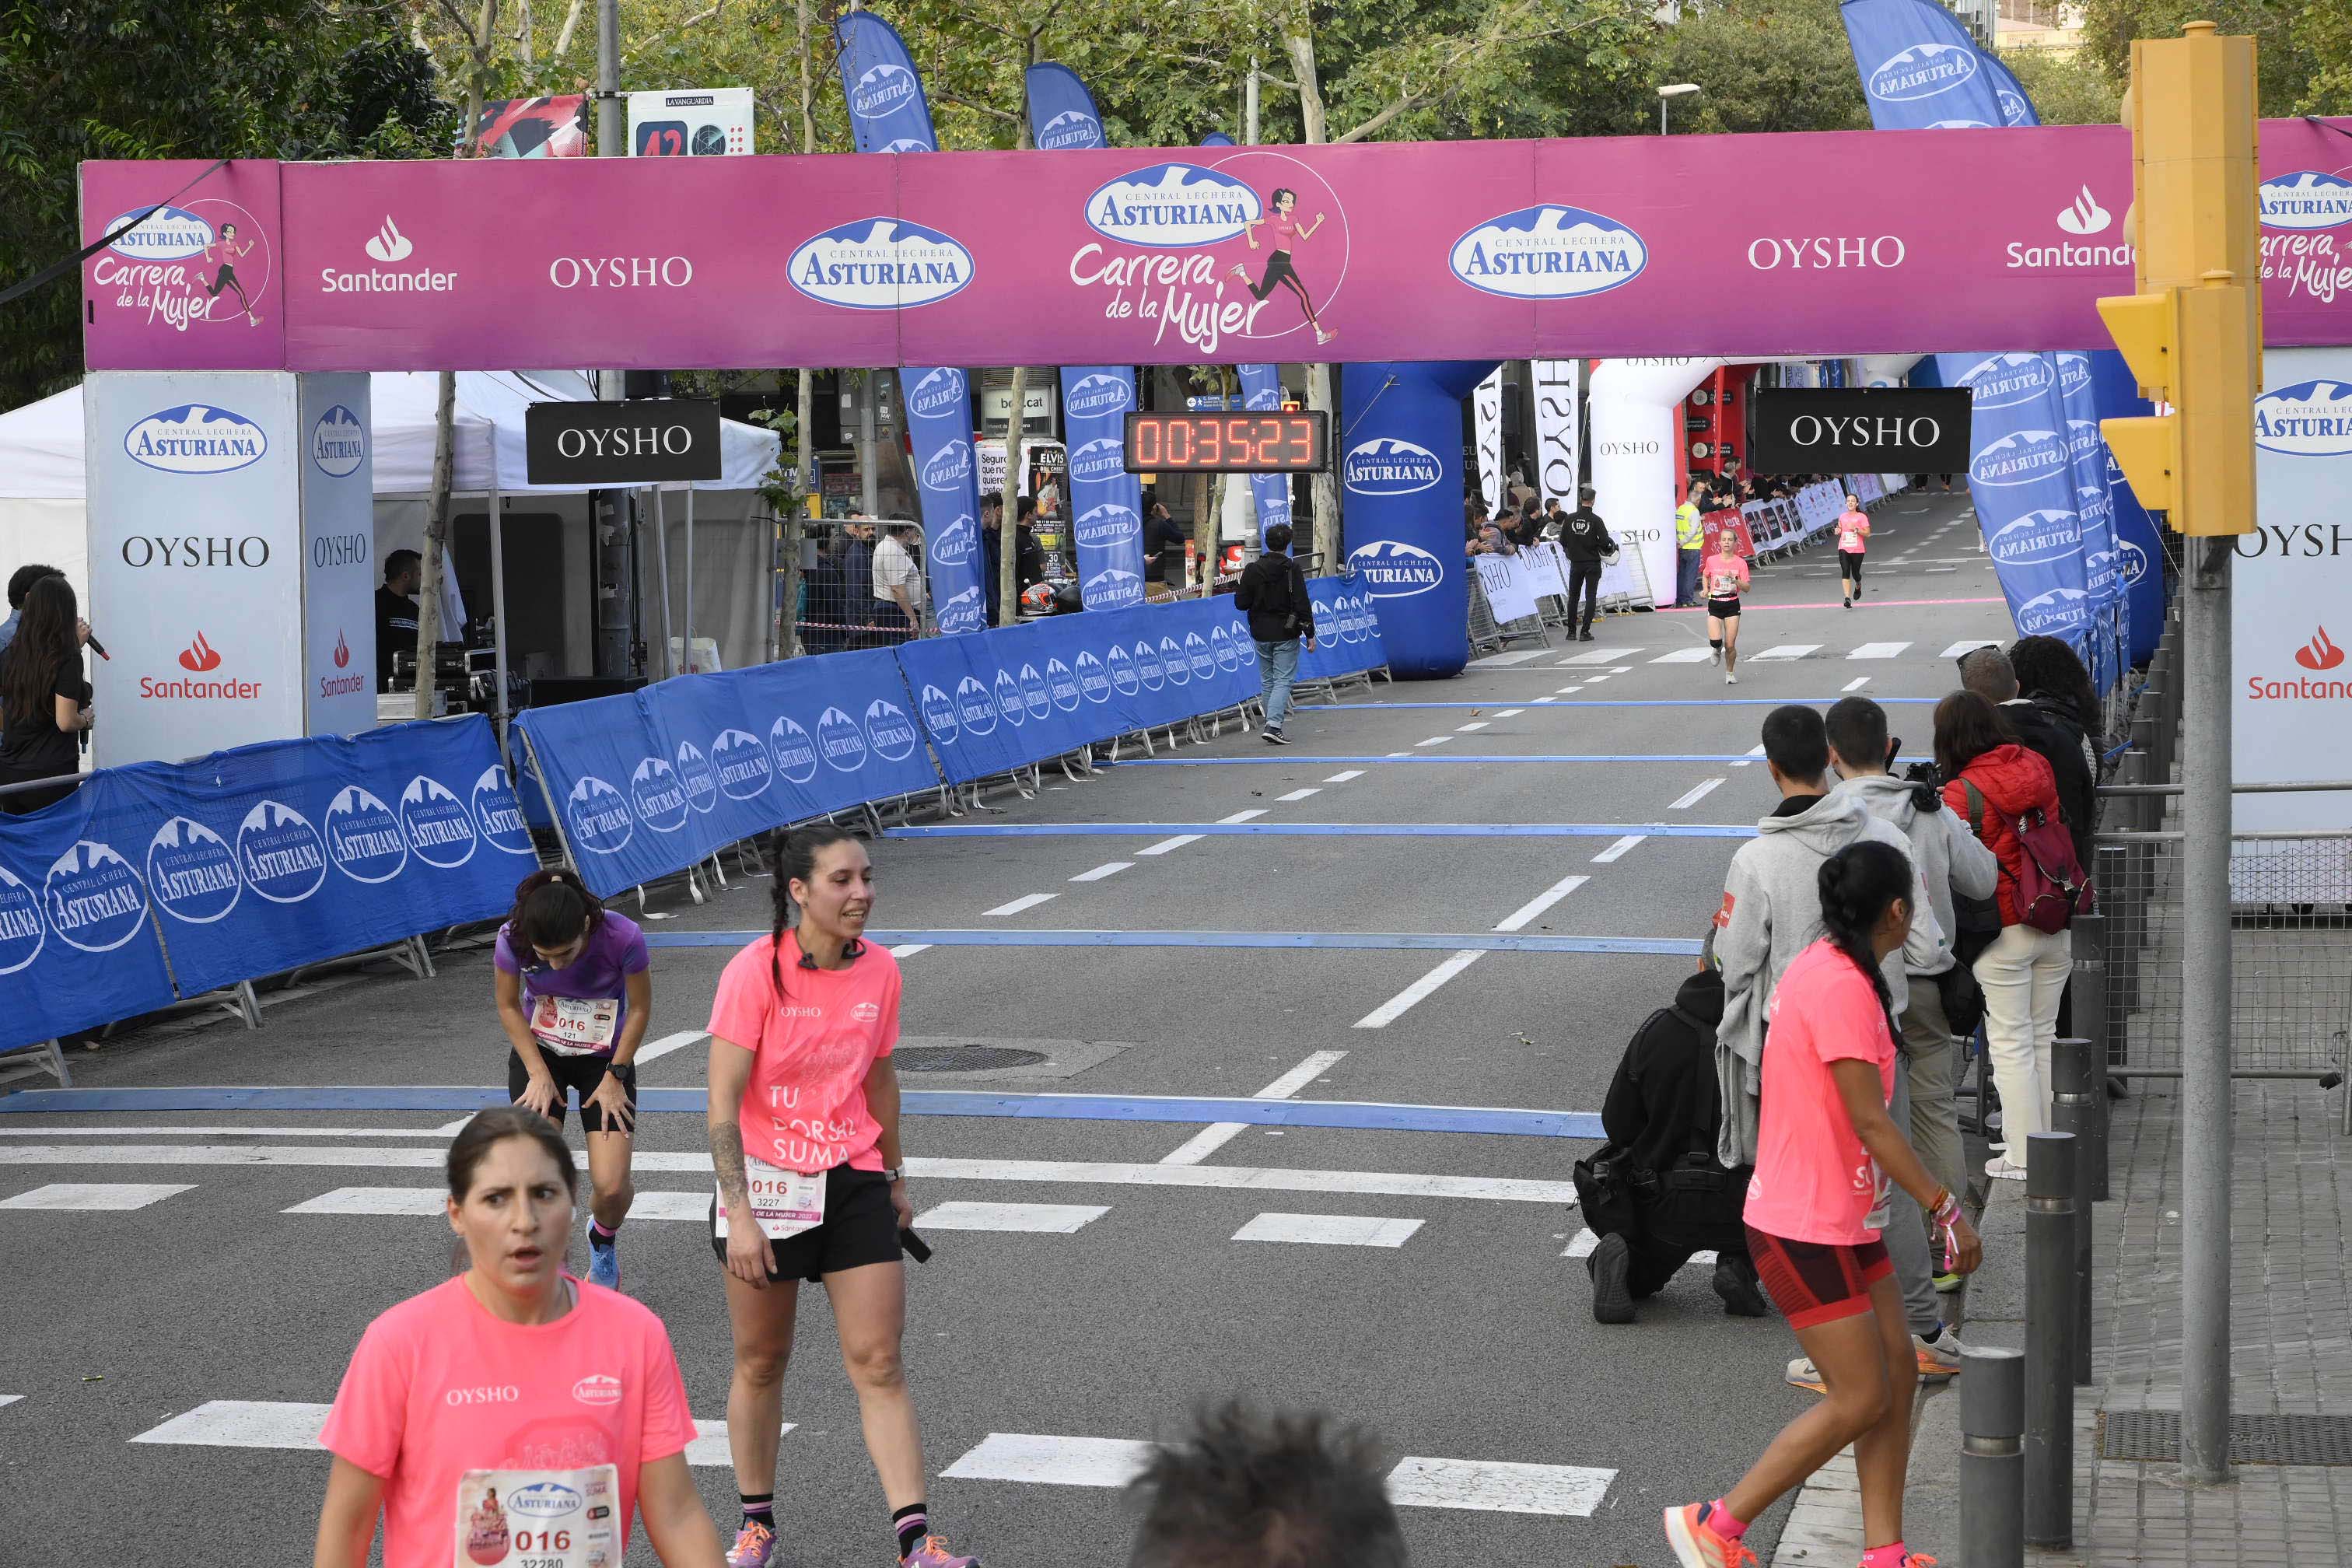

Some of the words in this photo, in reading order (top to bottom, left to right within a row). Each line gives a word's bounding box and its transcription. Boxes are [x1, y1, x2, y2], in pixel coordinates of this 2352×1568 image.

[1125, 191, 1181, 201] CENTRAL
[1187, 191, 1243, 200] LECHERA
[1098, 194, 1248, 226] ASTURIANA
[112, 224, 205, 247] ASTURIANA
[1496, 237, 1556, 247] CENTRAL
[1563, 236, 1626, 246] LECHERA
[2259, 234, 2334, 256] arrera
[830, 249, 889, 259] CENTRAL
[894, 248, 954, 258] LECHERA
[1069, 243, 1217, 286] Carrera
[1465, 240, 1632, 275] ASTURIANA
[1748, 236, 1906, 270] OYSHO
[93, 257, 186, 287] Carrera
[549, 256, 693, 289] OYSHO
[801, 252, 960, 285] ASTURIANA
[2278, 257, 2292, 278] la
[321, 268, 457, 292] Santander
[117, 287, 133, 308] de
[137, 286, 149, 308] la
[148, 284, 220, 331] Mujer
[1105, 289, 1132, 318] de
[1139, 285, 1157, 318] la
[1153, 279, 1269, 354] Mujer
[558, 425, 692, 458] OYSHO
[1138, 420, 1311, 464] 00:35:23
[1790, 415, 1940, 447] OYSHO
[136, 430, 257, 457] ASTURIANA
[316, 432, 362, 460] ASTURIANA
[1600, 441, 1659, 456] OYSHO
[1040, 453, 1064, 464] ELVIS
[982, 467, 995, 475] que
[1347, 461, 1435, 483] ASTURIANA
[122, 536, 269, 568] OYSHO
[314, 533, 366, 568] OYSHO
[1048, 554, 1058, 562] 30
[140, 677, 262, 699] Santander
[321, 672, 364, 698] Santander
[774, 744, 814, 768] ASTURIANA
[822, 733, 864, 758] ASTURIANA
[715, 757, 770, 786] ASTURIANA
[340, 819, 366, 831] CENTRAL
[367, 815, 392, 827] LECHERA
[413, 807, 436, 818] CENTRAL
[436, 804, 460, 815] LECHERA
[253, 835, 281, 849] CENTRAL
[282, 830, 311, 844] LECHERA
[406, 813, 473, 849] ASTURIANA
[333, 824, 404, 863] ASTURIANA
[165, 853, 195, 866] CENTRAL
[196, 848, 225, 862] LECHERA
[245, 843, 323, 883] ASTURIANA
[156, 861, 237, 902] ASTURIANA
[54, 884, 142, 930] ASTURIANA
[558, 1017, 586, 1031] 016
[781, 1006, 821, 1018] OYSHO
[770, 1086, 800, 1108] TU
[773, 1138, 849, 1166] SUMA
[751, 1180, 788, 1195] 016
[757, 1198, 780, 1207] 3227
[446, 1385, 520, 1406] OYSHO
[513, 1496, 577, 1509] ASTURIANA
[516, 1531, 571, 1551] 016
[520, 1559, 564, 1568] 32280
